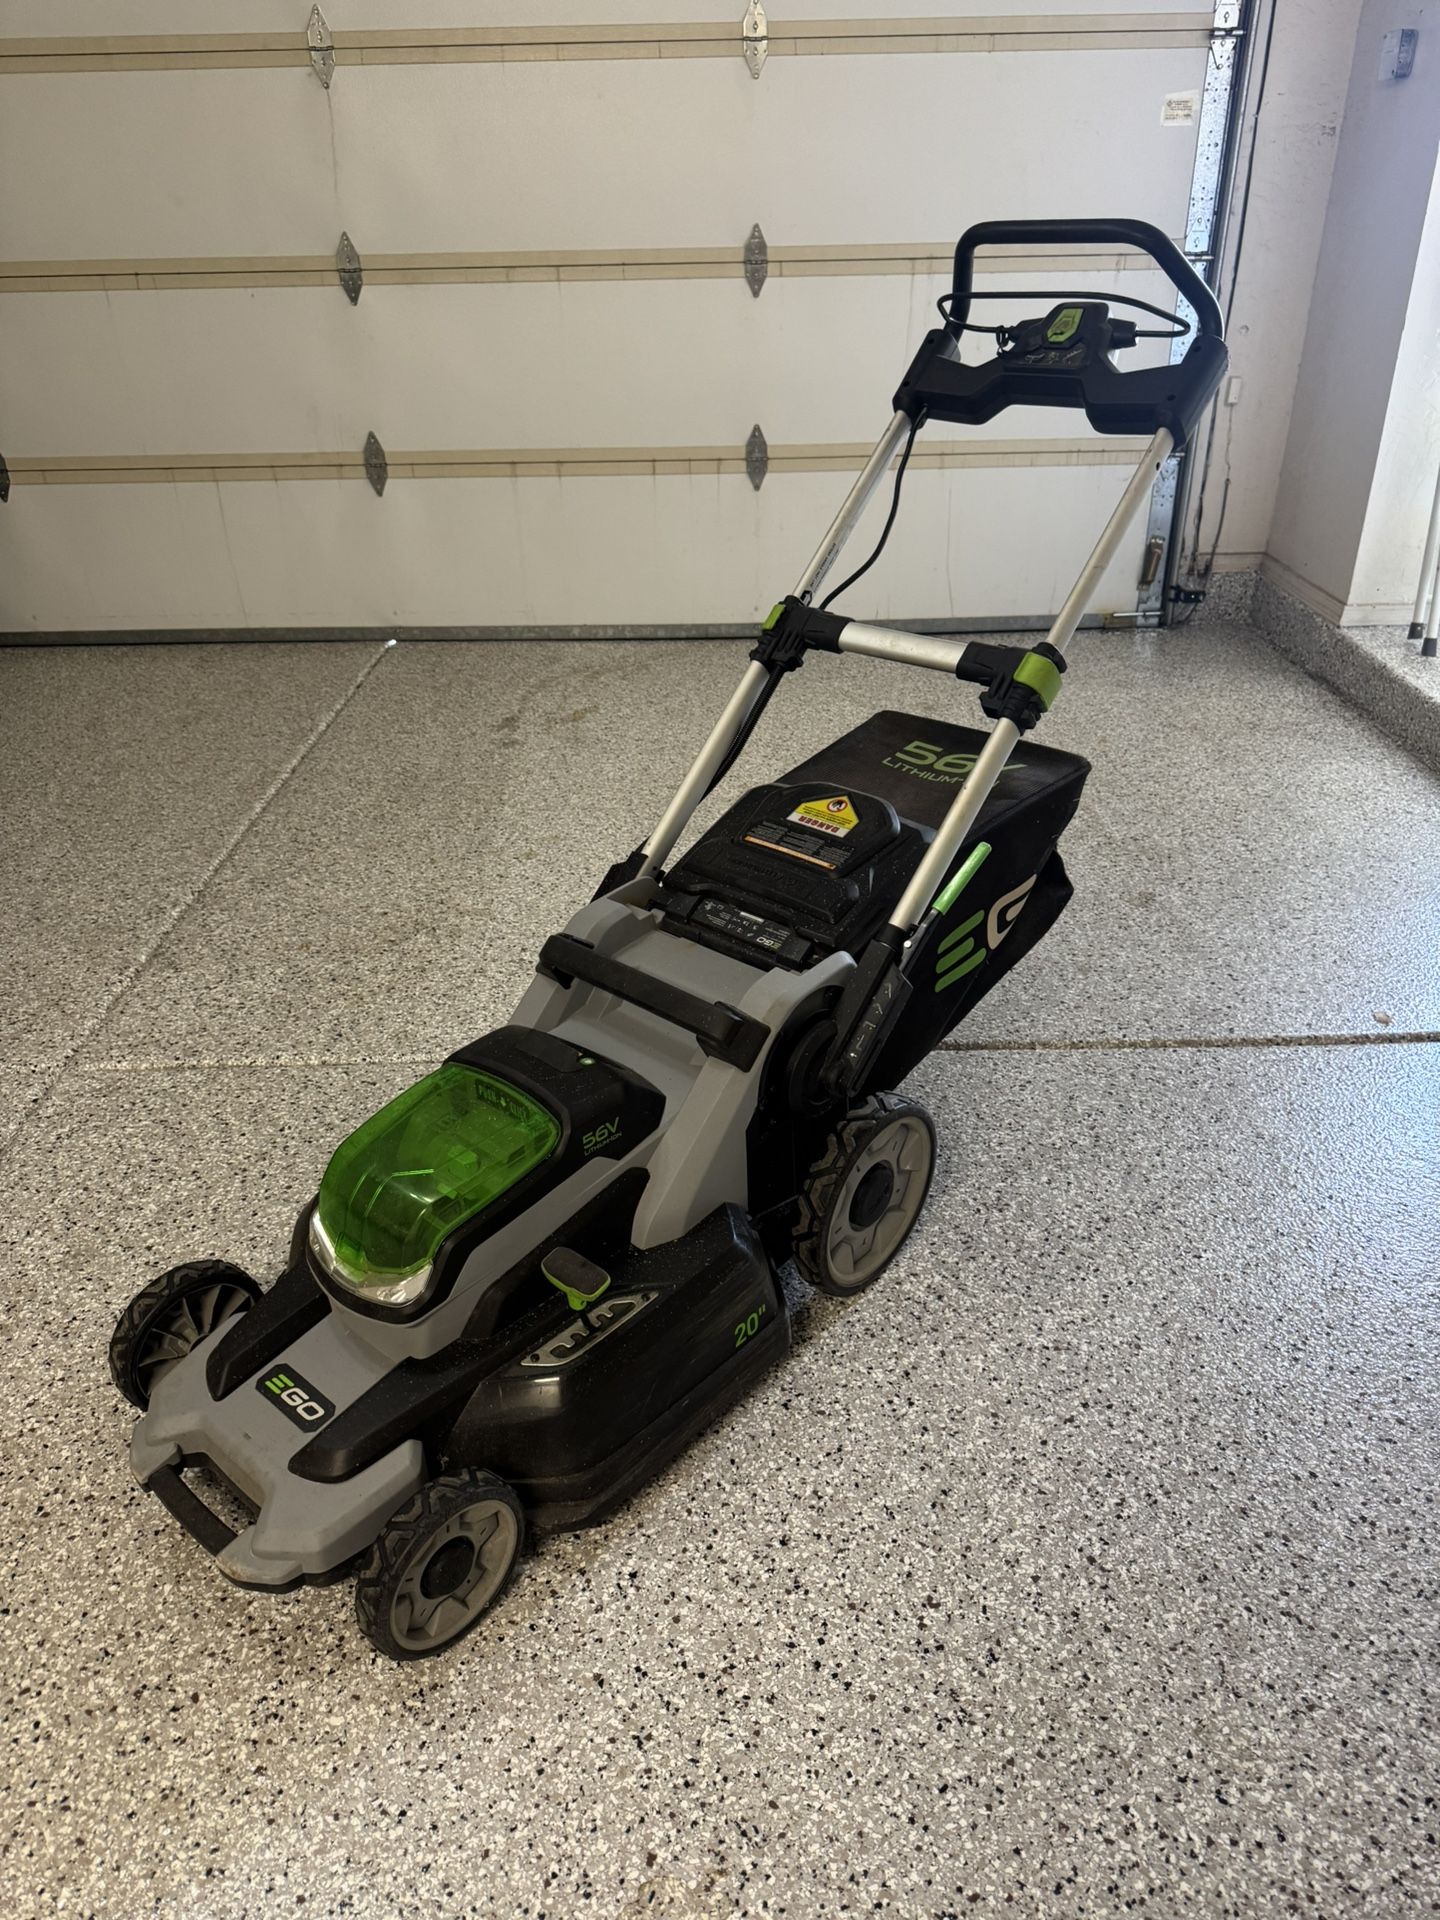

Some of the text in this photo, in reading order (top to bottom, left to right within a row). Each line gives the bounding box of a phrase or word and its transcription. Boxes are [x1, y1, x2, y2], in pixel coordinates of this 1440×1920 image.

[798, 815, 841, 833] DANGER
[934, 873, 1037, 993] EG
[583, 1116, 620, 1149] 56V
[735, 1303, 766, 1348] 20"
[265, 1374, 325, 1421] EGO
